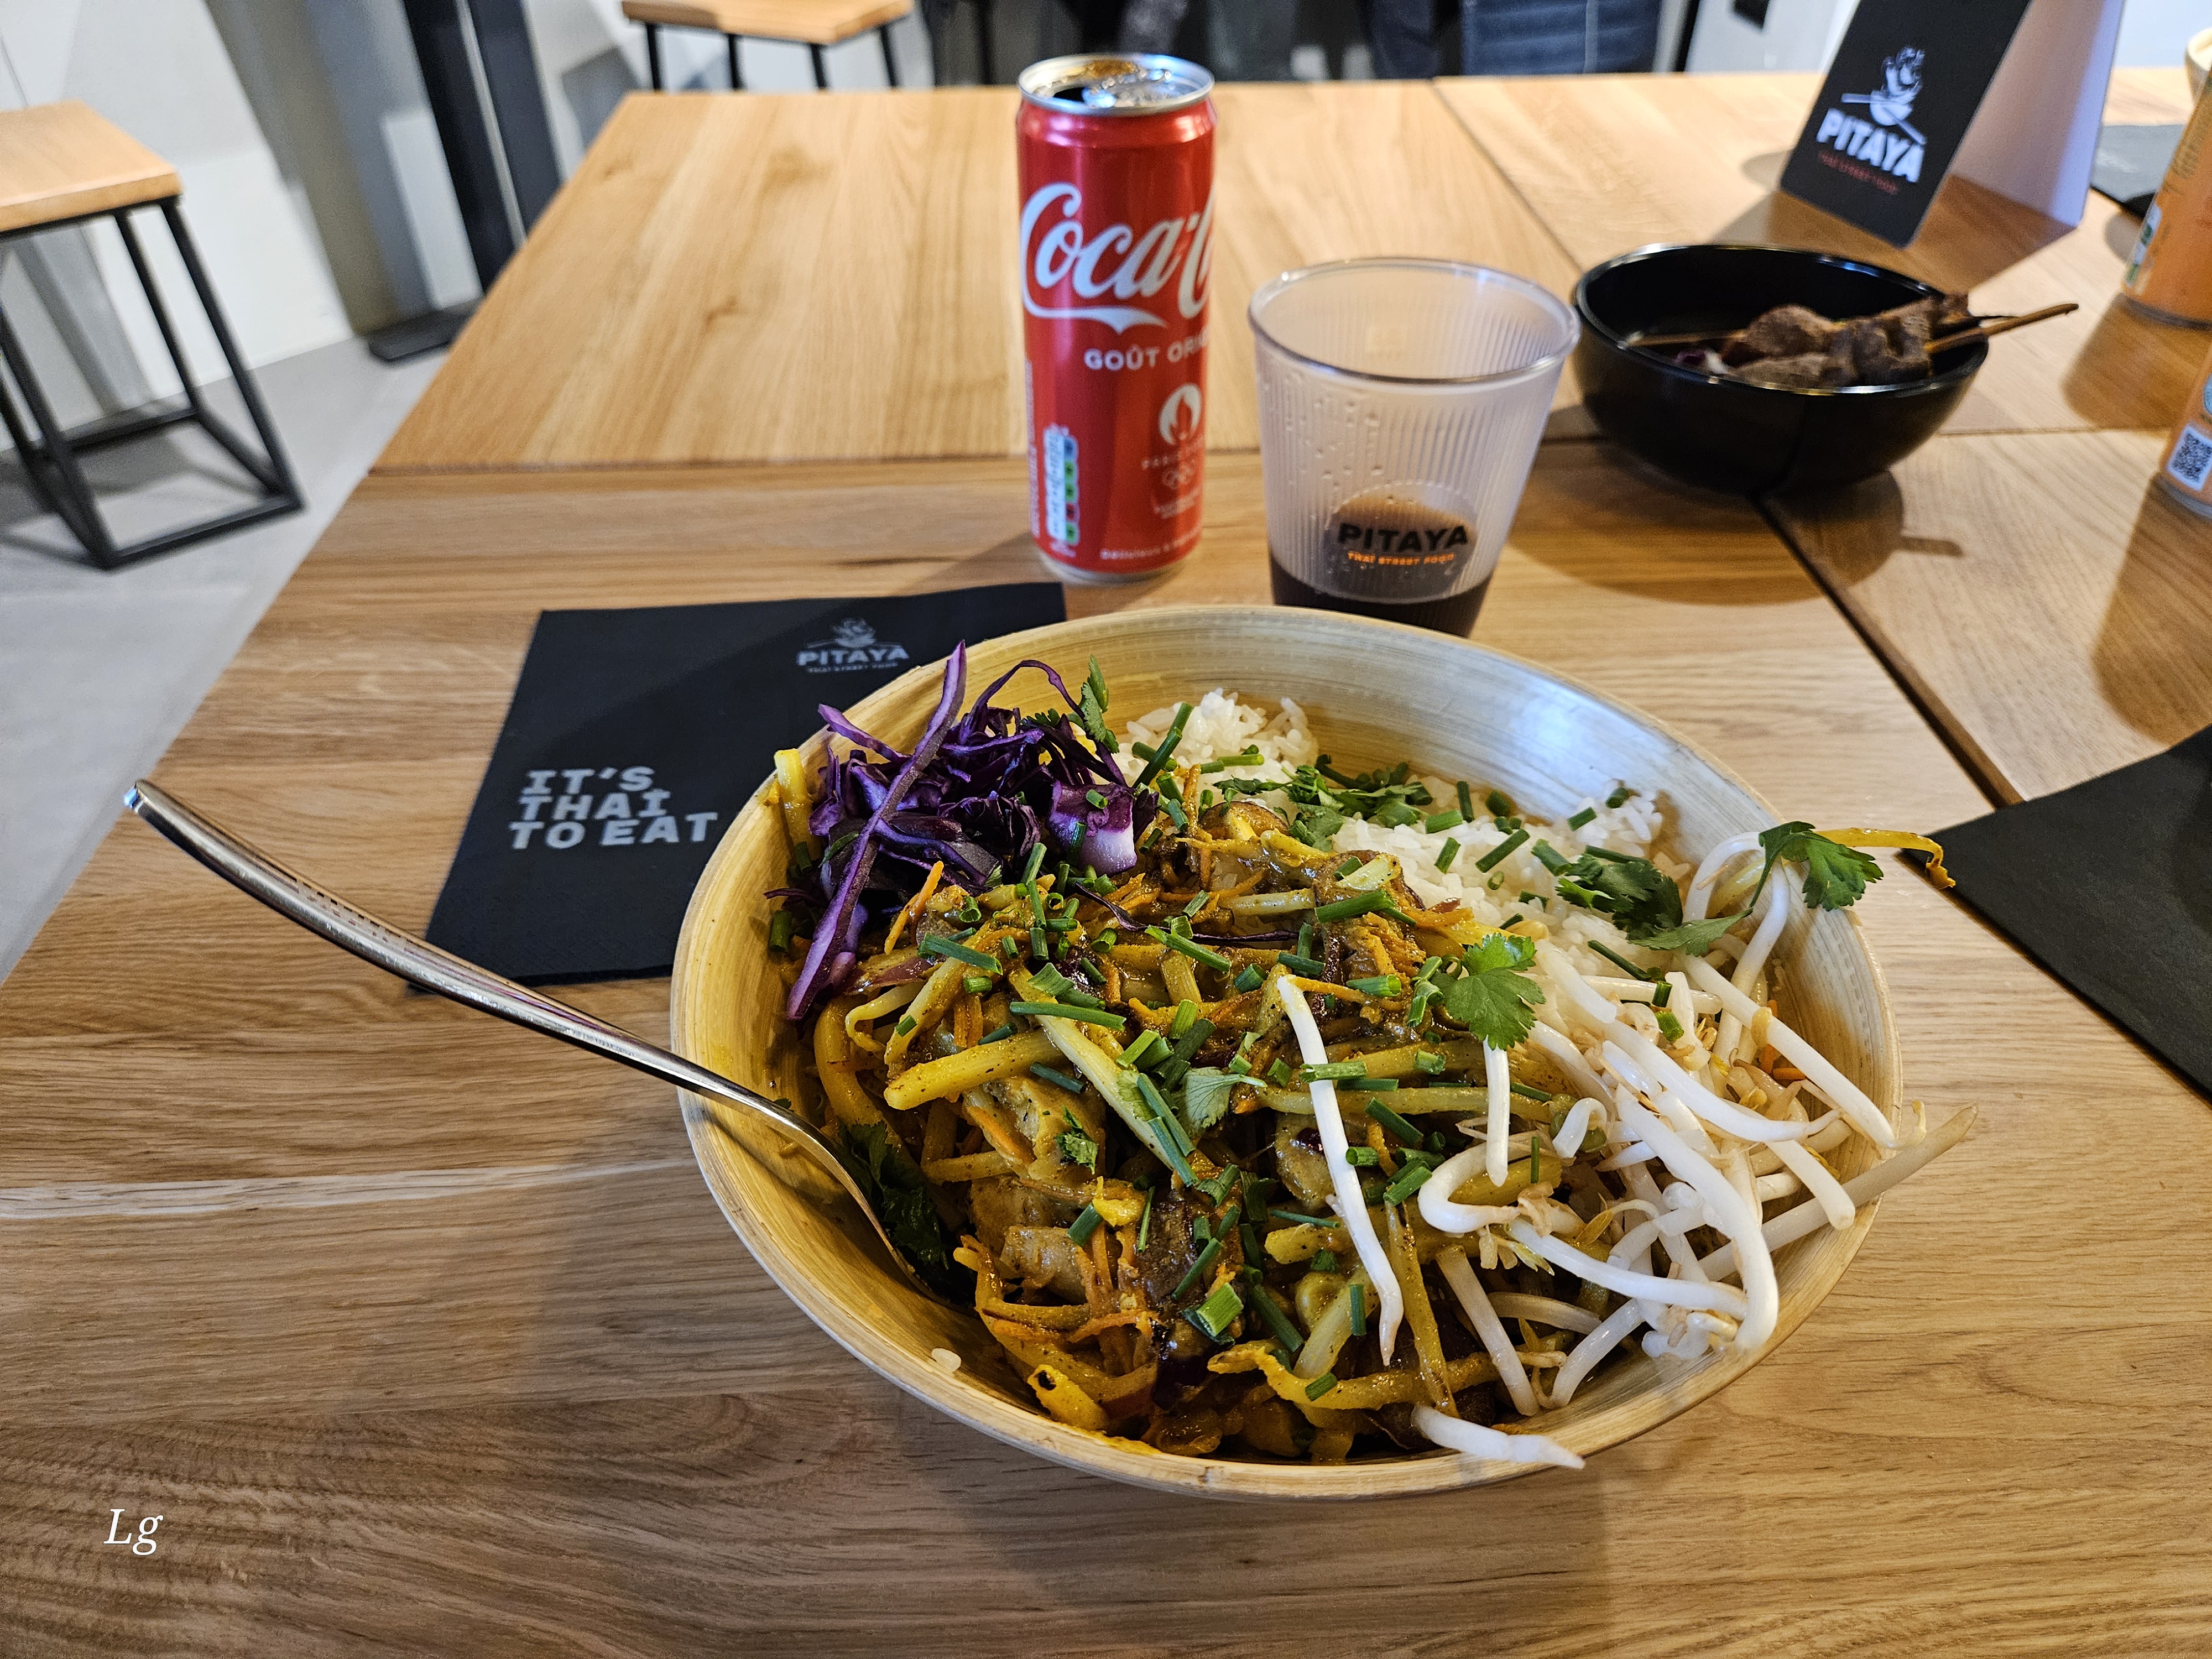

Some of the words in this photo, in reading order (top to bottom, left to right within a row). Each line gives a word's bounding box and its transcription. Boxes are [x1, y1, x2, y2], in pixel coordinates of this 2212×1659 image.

[1816, 108, 1925, 183] PITAYA
[1084, 344, 1160, 371] GOÛT
[1337, 523, 1468, 552] PITAYA
[797, 645, 909, 666] PITAYA
[521, 766, 655, 795] IT'S
[518, 789, 671, 821] THAI
[508, 821, 586, 849] TO
[600, 812, 718, 846] EAT
